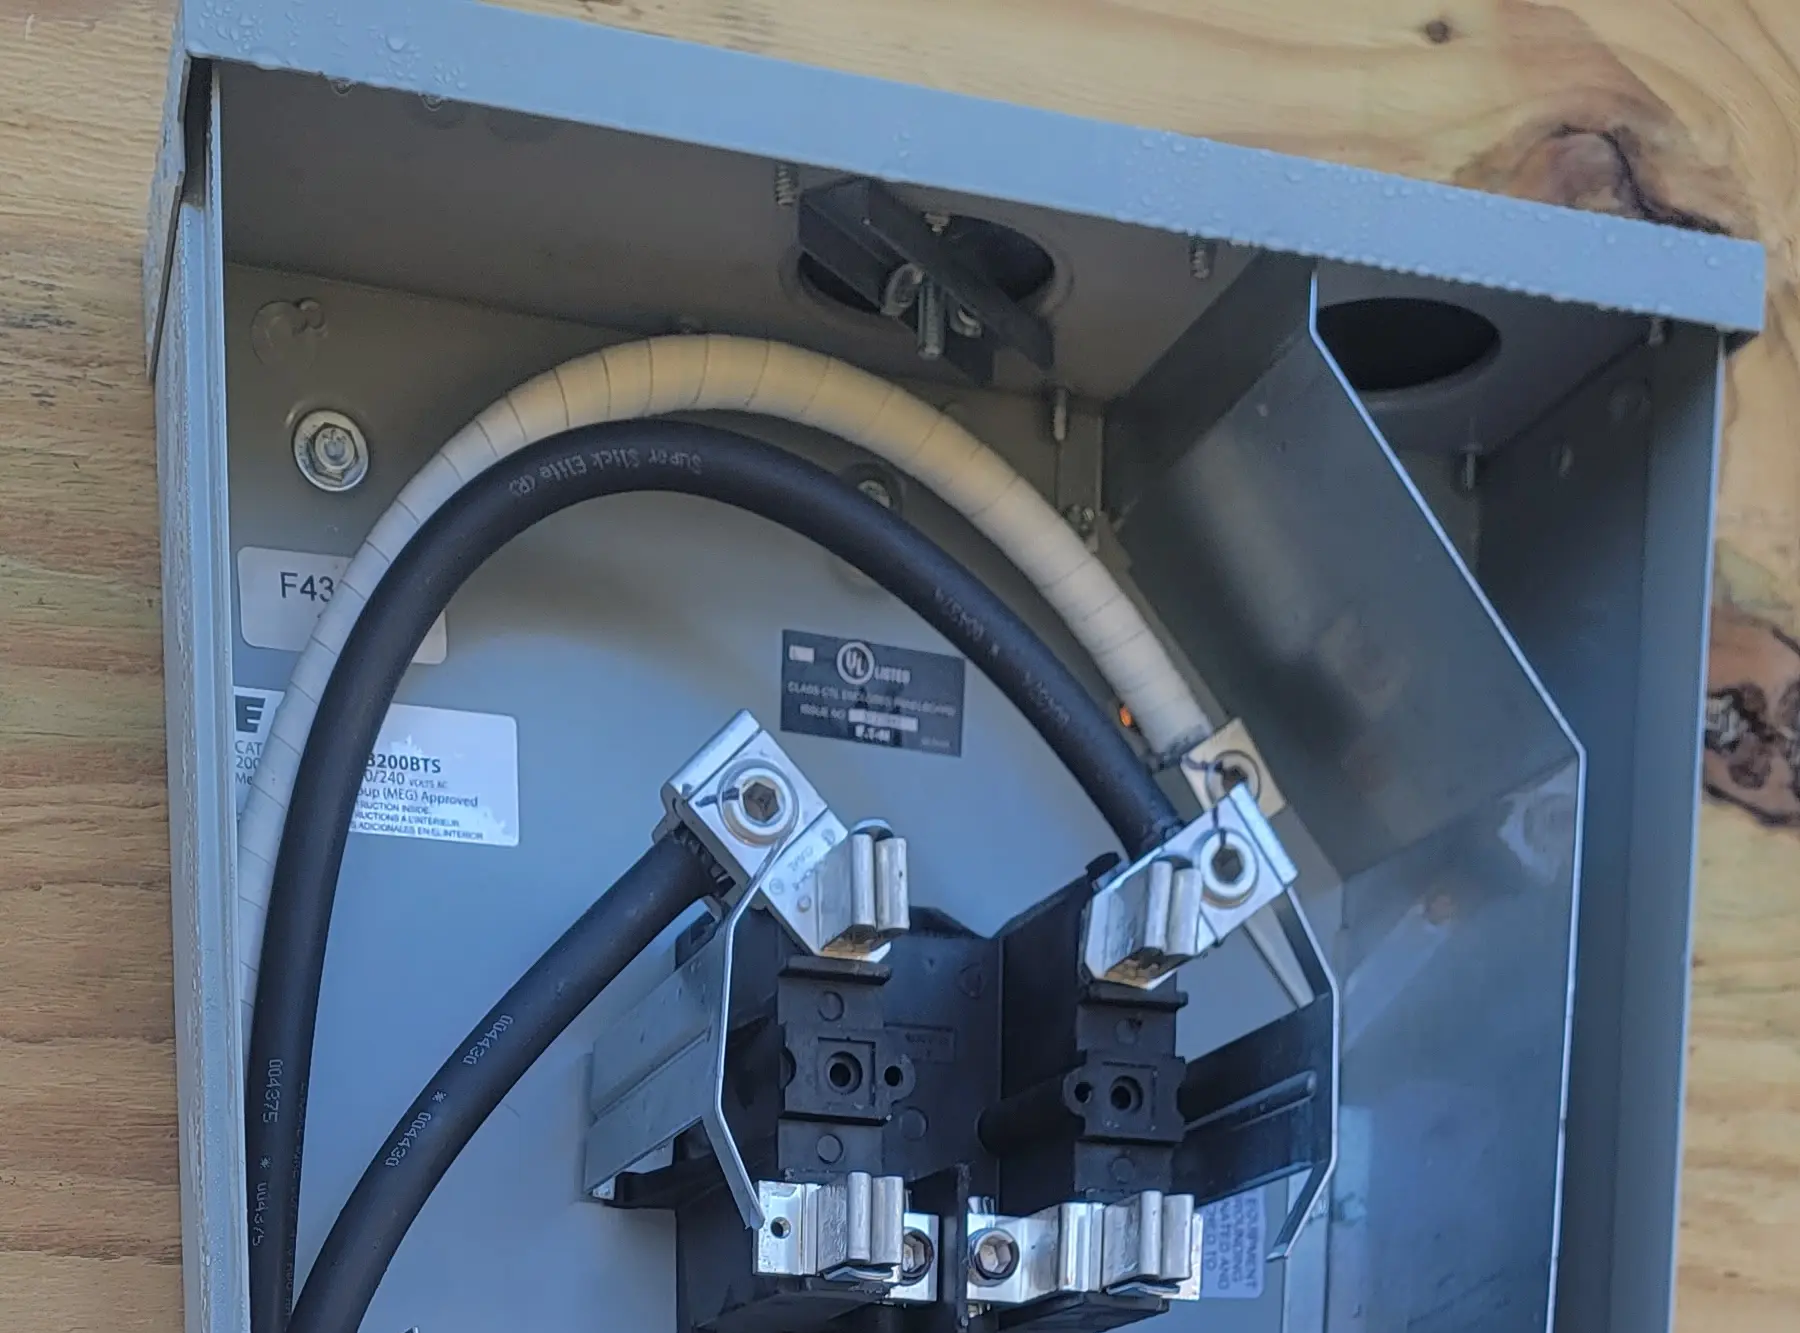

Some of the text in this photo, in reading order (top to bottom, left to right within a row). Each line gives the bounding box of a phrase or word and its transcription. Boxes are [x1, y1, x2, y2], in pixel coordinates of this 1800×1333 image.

[540, 453, 588, 482] Elite
[845, 651, 865, 677] UL
[383, 786, 418, 801] (MEG)
[421, 791, 479, 808] Approved
